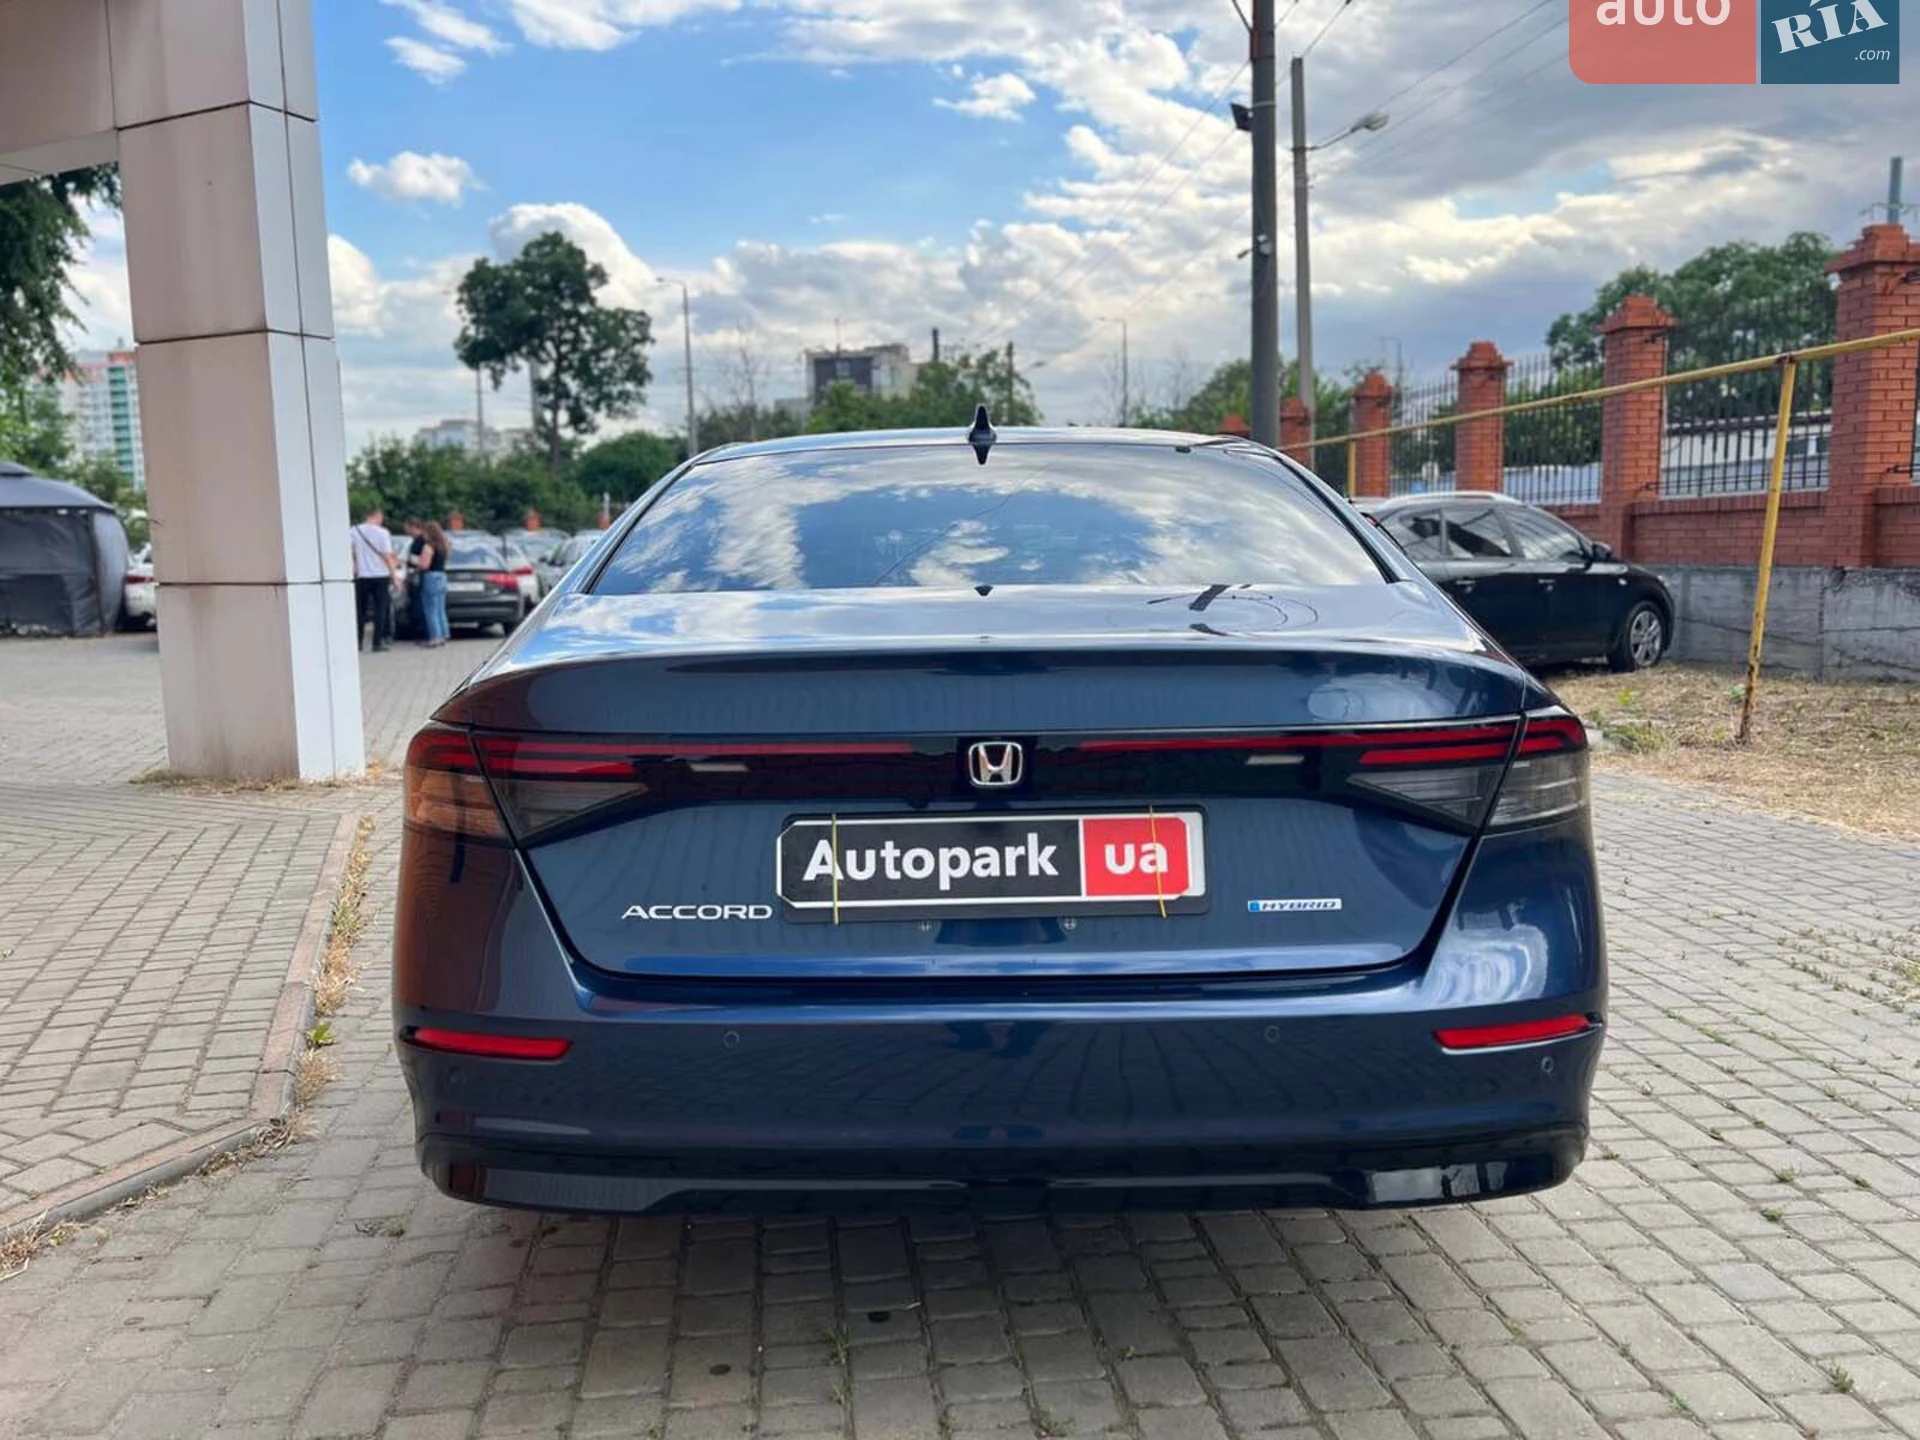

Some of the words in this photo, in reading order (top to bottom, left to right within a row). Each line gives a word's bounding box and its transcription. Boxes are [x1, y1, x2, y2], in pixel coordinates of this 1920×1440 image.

[802, 832, 1060, 891] Autopark
[1103, 840, 1169, 875] ua
[621, 904, 773, 920] ACCORD
[1261, 900, 1339, 911] HYBRID
